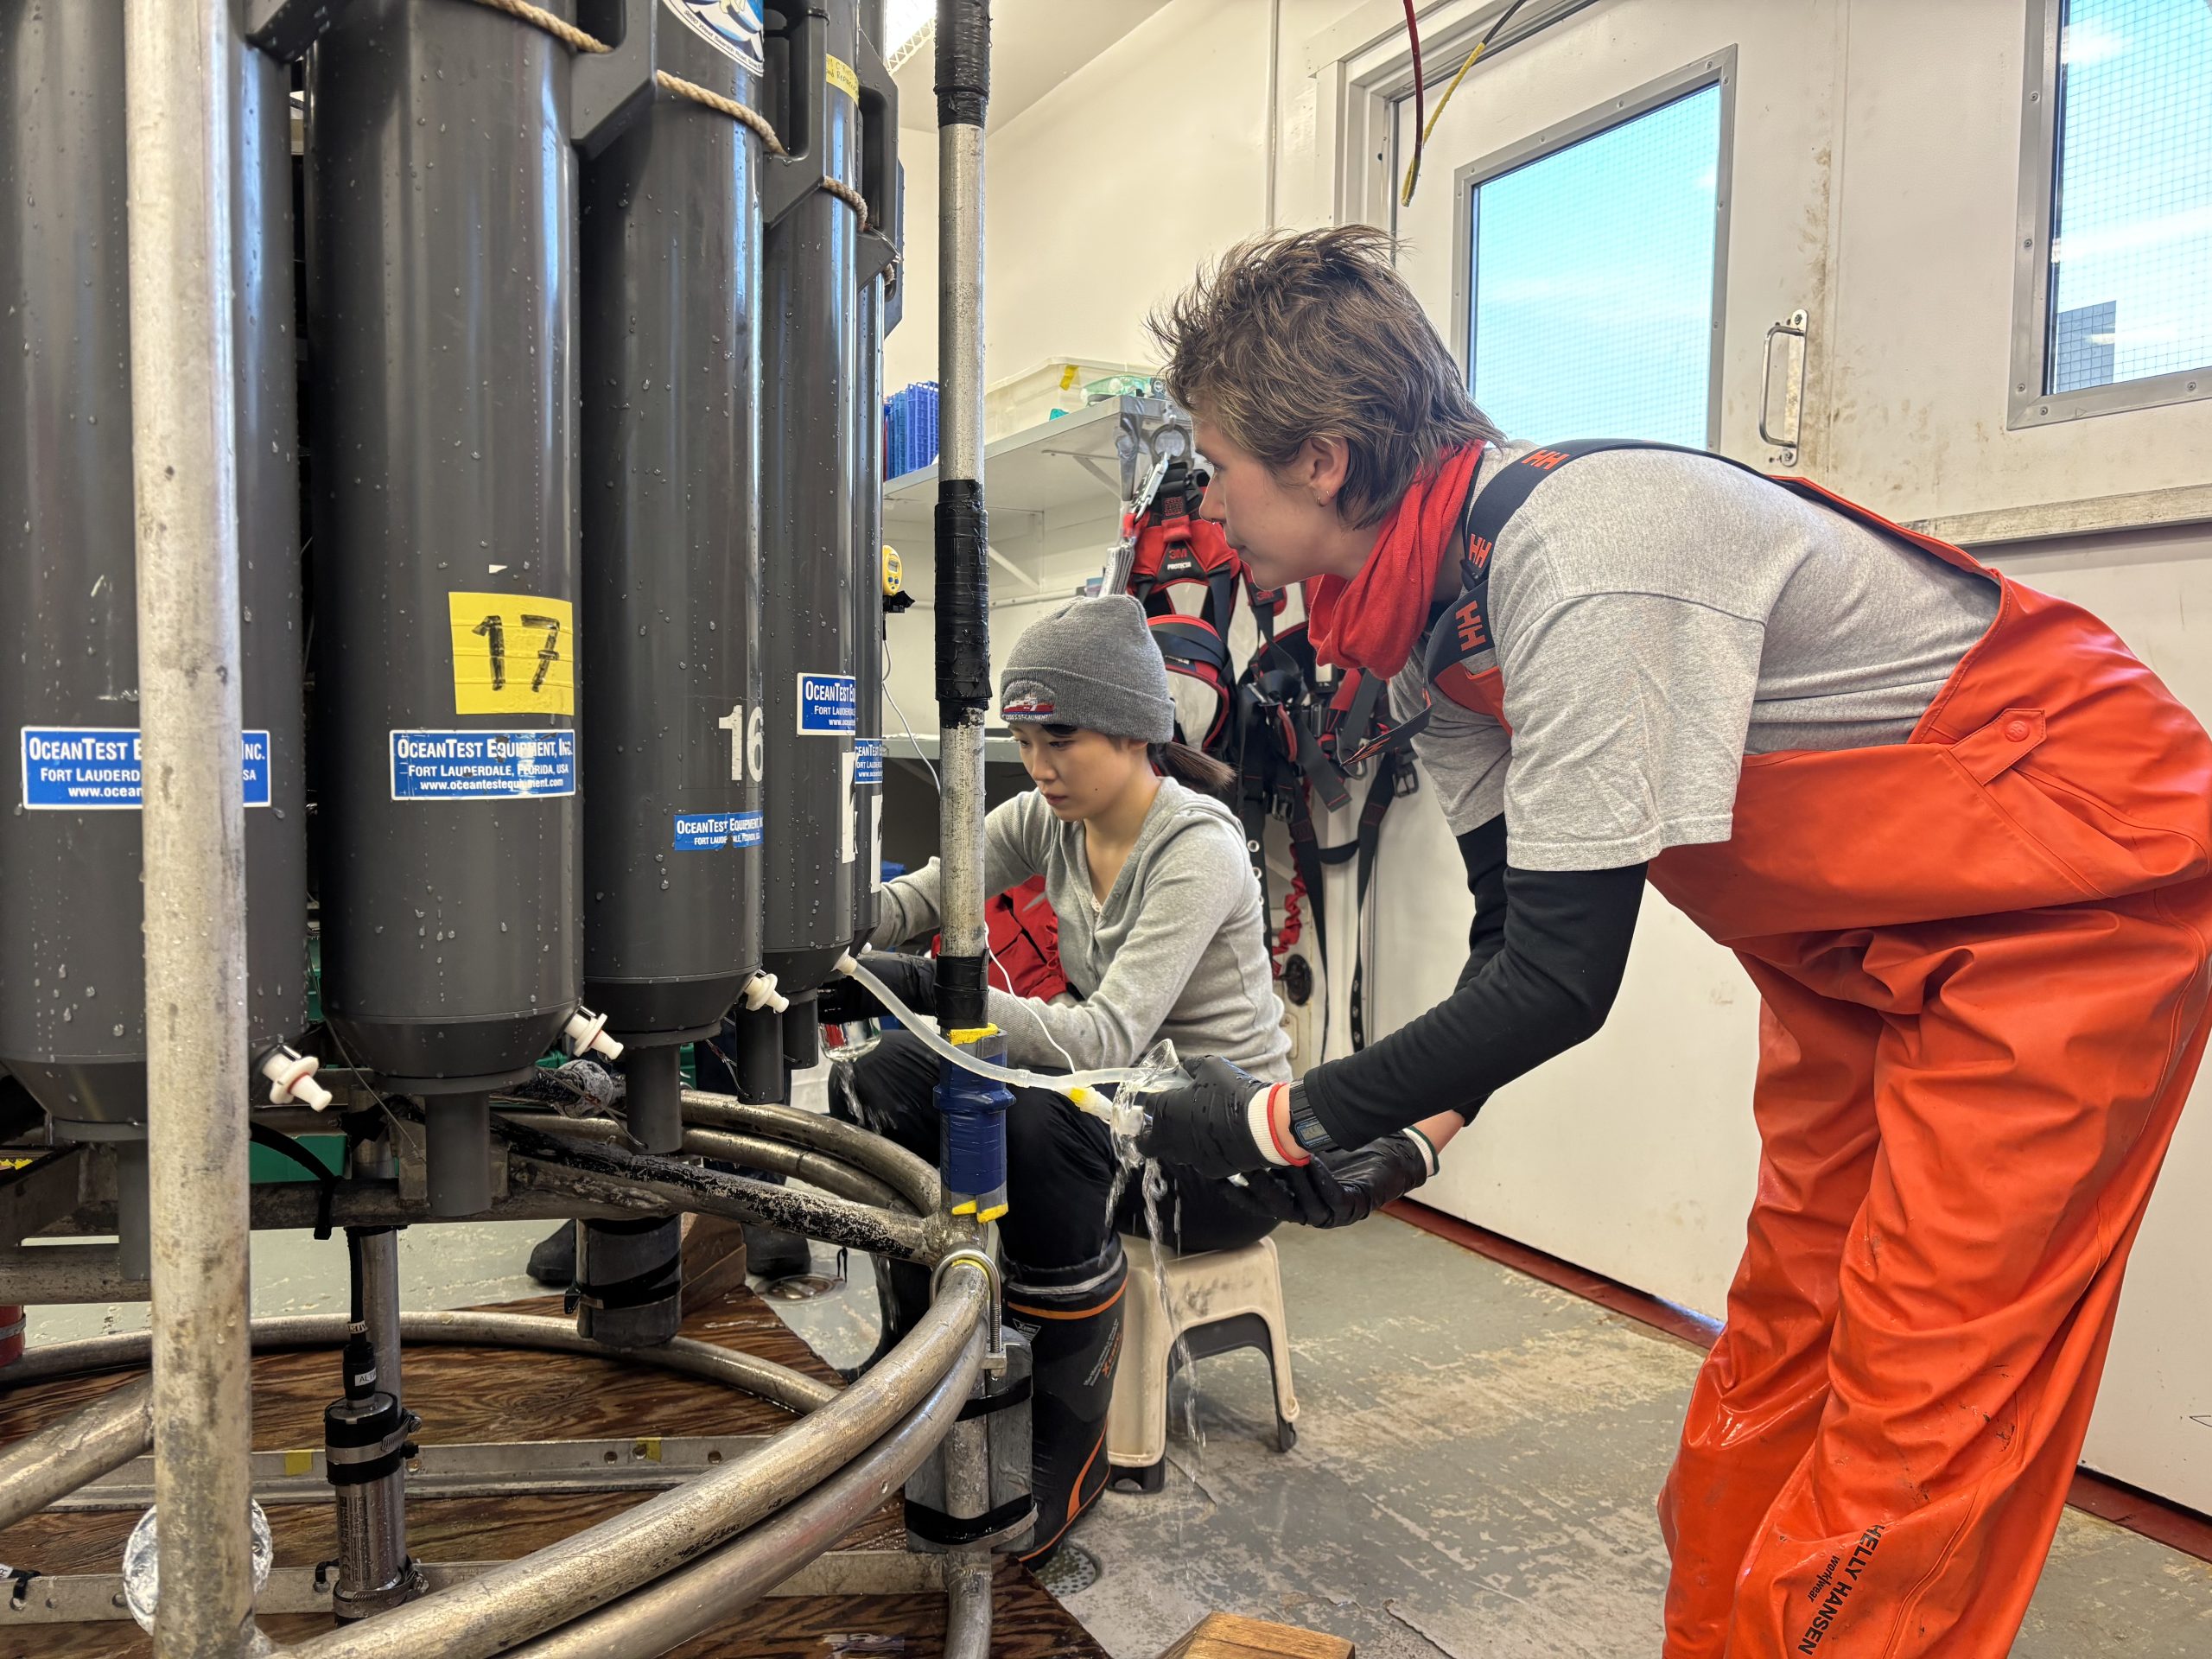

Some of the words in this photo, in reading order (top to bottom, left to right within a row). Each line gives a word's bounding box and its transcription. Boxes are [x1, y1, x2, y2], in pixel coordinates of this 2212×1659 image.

[1521, 449, 1570, 470] HH
[1169, 548, 1188, 560] 3M
[1469, 533, 1492, 568] HH
[1455, 600, 1486, 652] HH
[471, 614, 560, 693] 17
[814, 705, 831, 715] FORT
[718, 704, 764, 782] 16
[41, 767, 73, 782] FORT
[76, 767, 141, 782] LAUDERD
[242, 769, 257, 781] SA
[409, 764, 437, 777] FORT
[441, 764, 515, 778] LAUDERDALE,
[556, 764, 569, 774] USA
[68, 787, 143, 798] www.ocean
[420, 779, 564, 791] www.oceantestequipment.com
[694, 836, 709, 846] FORT
[1845, 1524, 1886, 1581] HELLY
[1797, 1581, 1853, 1656] HANSEN
